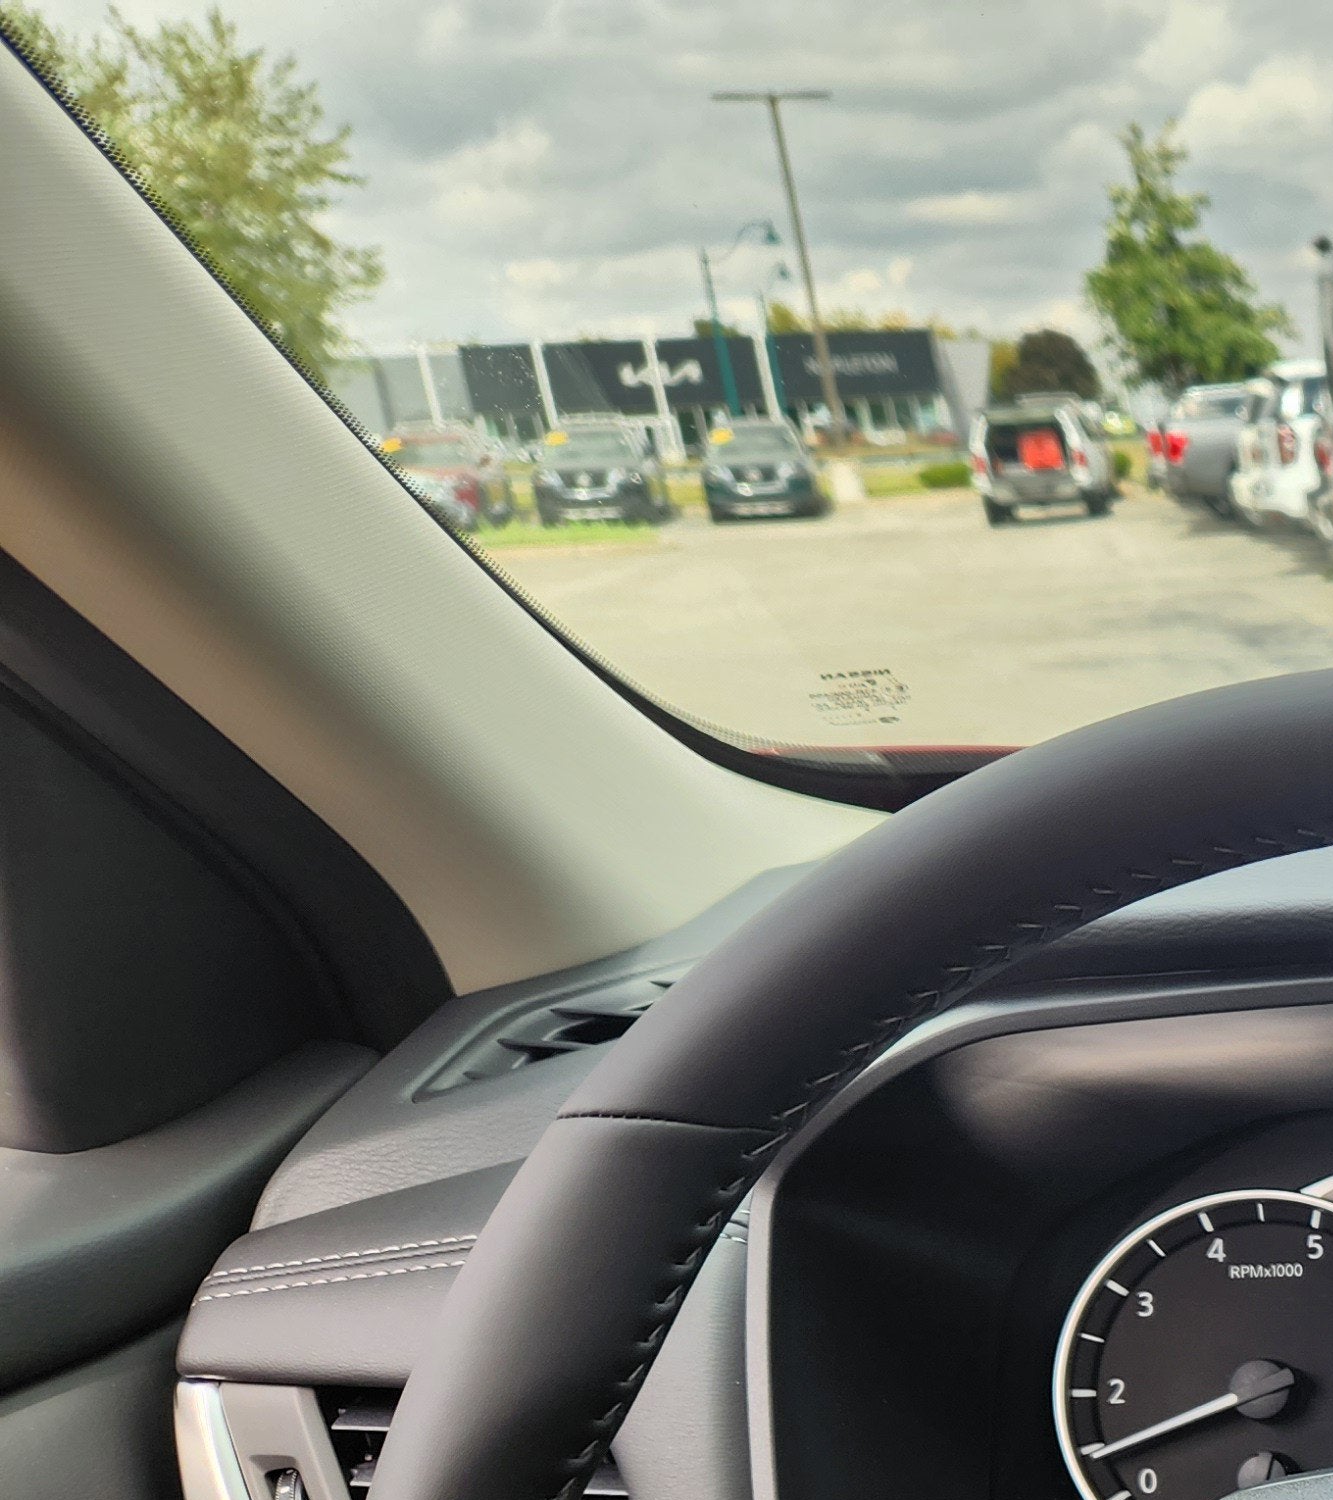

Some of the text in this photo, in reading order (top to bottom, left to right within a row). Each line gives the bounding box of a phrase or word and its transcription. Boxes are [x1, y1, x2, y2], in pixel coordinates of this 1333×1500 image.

[1207, 1239, 1226, 1262] 4
[1307, 1235, 1324, 1260] 5
[1229, 1263, 1303, 1279] RPMx1000
[1137, 1292, 1154, 1317] 3
[1109, 1380, 1126, 1404] 2
[1140, 1469, 1157, 1494] 0
